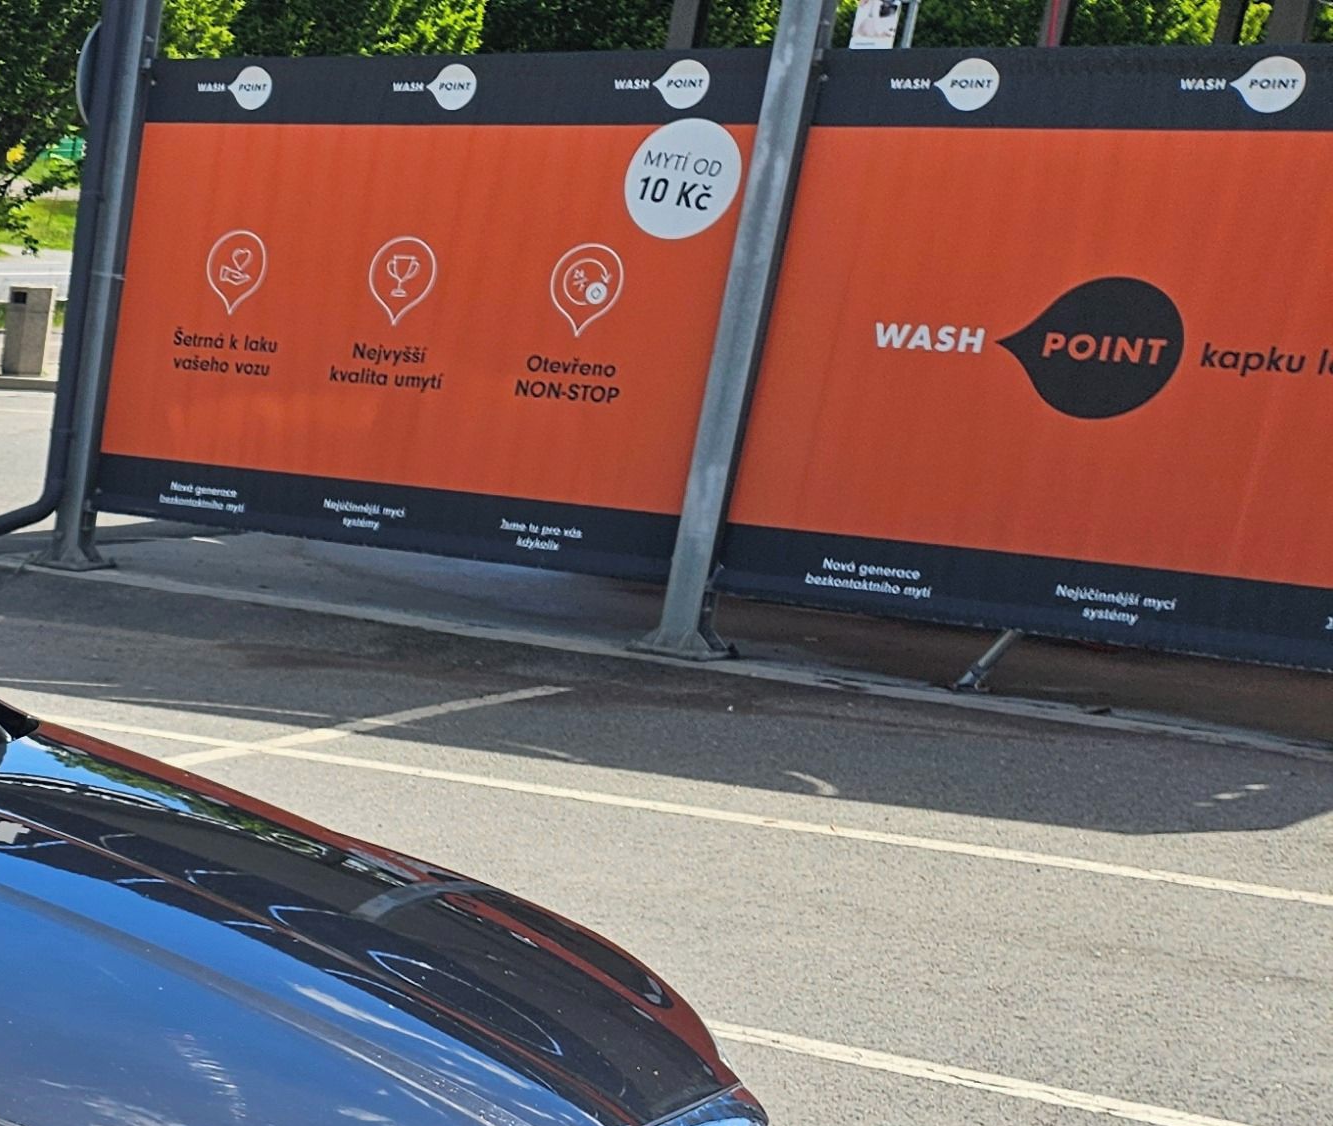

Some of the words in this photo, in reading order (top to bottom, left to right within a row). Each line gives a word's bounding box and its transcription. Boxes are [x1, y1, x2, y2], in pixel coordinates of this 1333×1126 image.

[197, 82, 226, 92] WASH
[238, 83, 267, 92] POINT
[393, 81, 424, 92] WASH
[438, 82, 471, 91] POINT
[614, 78, 650, 90] WASH
[666, 78, 704, 89] POINT
[890, 78, 931, 90] WASH
[950, 79, 993, 89] POINT
[1180, 78, 1227, 90] WASH
[1248, 78, 1299, 90] POINT
[644, 150, 691, 172] MYTÍ
[693, 158, 722, 177] OD
[639, 176, 669, 203] 10
[675, 181, 712, 211] Kč
[173, 326, 224, 349] Šetrná
[229, 333, 237, 350] k
[244, 335, 278, 353] laku
[875, 322, 985, 354] WASH
[1041, 331, 1169, 366] POINT
[1200, 342, 1306, 376] kapku
[173, 355, 229, 373] vašeho
[235, 361, 270, 377] vozu
[352, 342, 428, 367] Nejvyšší
[526, 355, 616, 378] Otevřeno
[329, 365, 388, 386] kvalita
[394, 373, 444, 393] umytí
[514, 379, 620, 404] NON-STOP
[822, 557, 856, 573] Nová
[858, 564, 921, 580] generace
[903, 585, 933, 600] mytí
[1142, 597, 1178, 612] mycí
